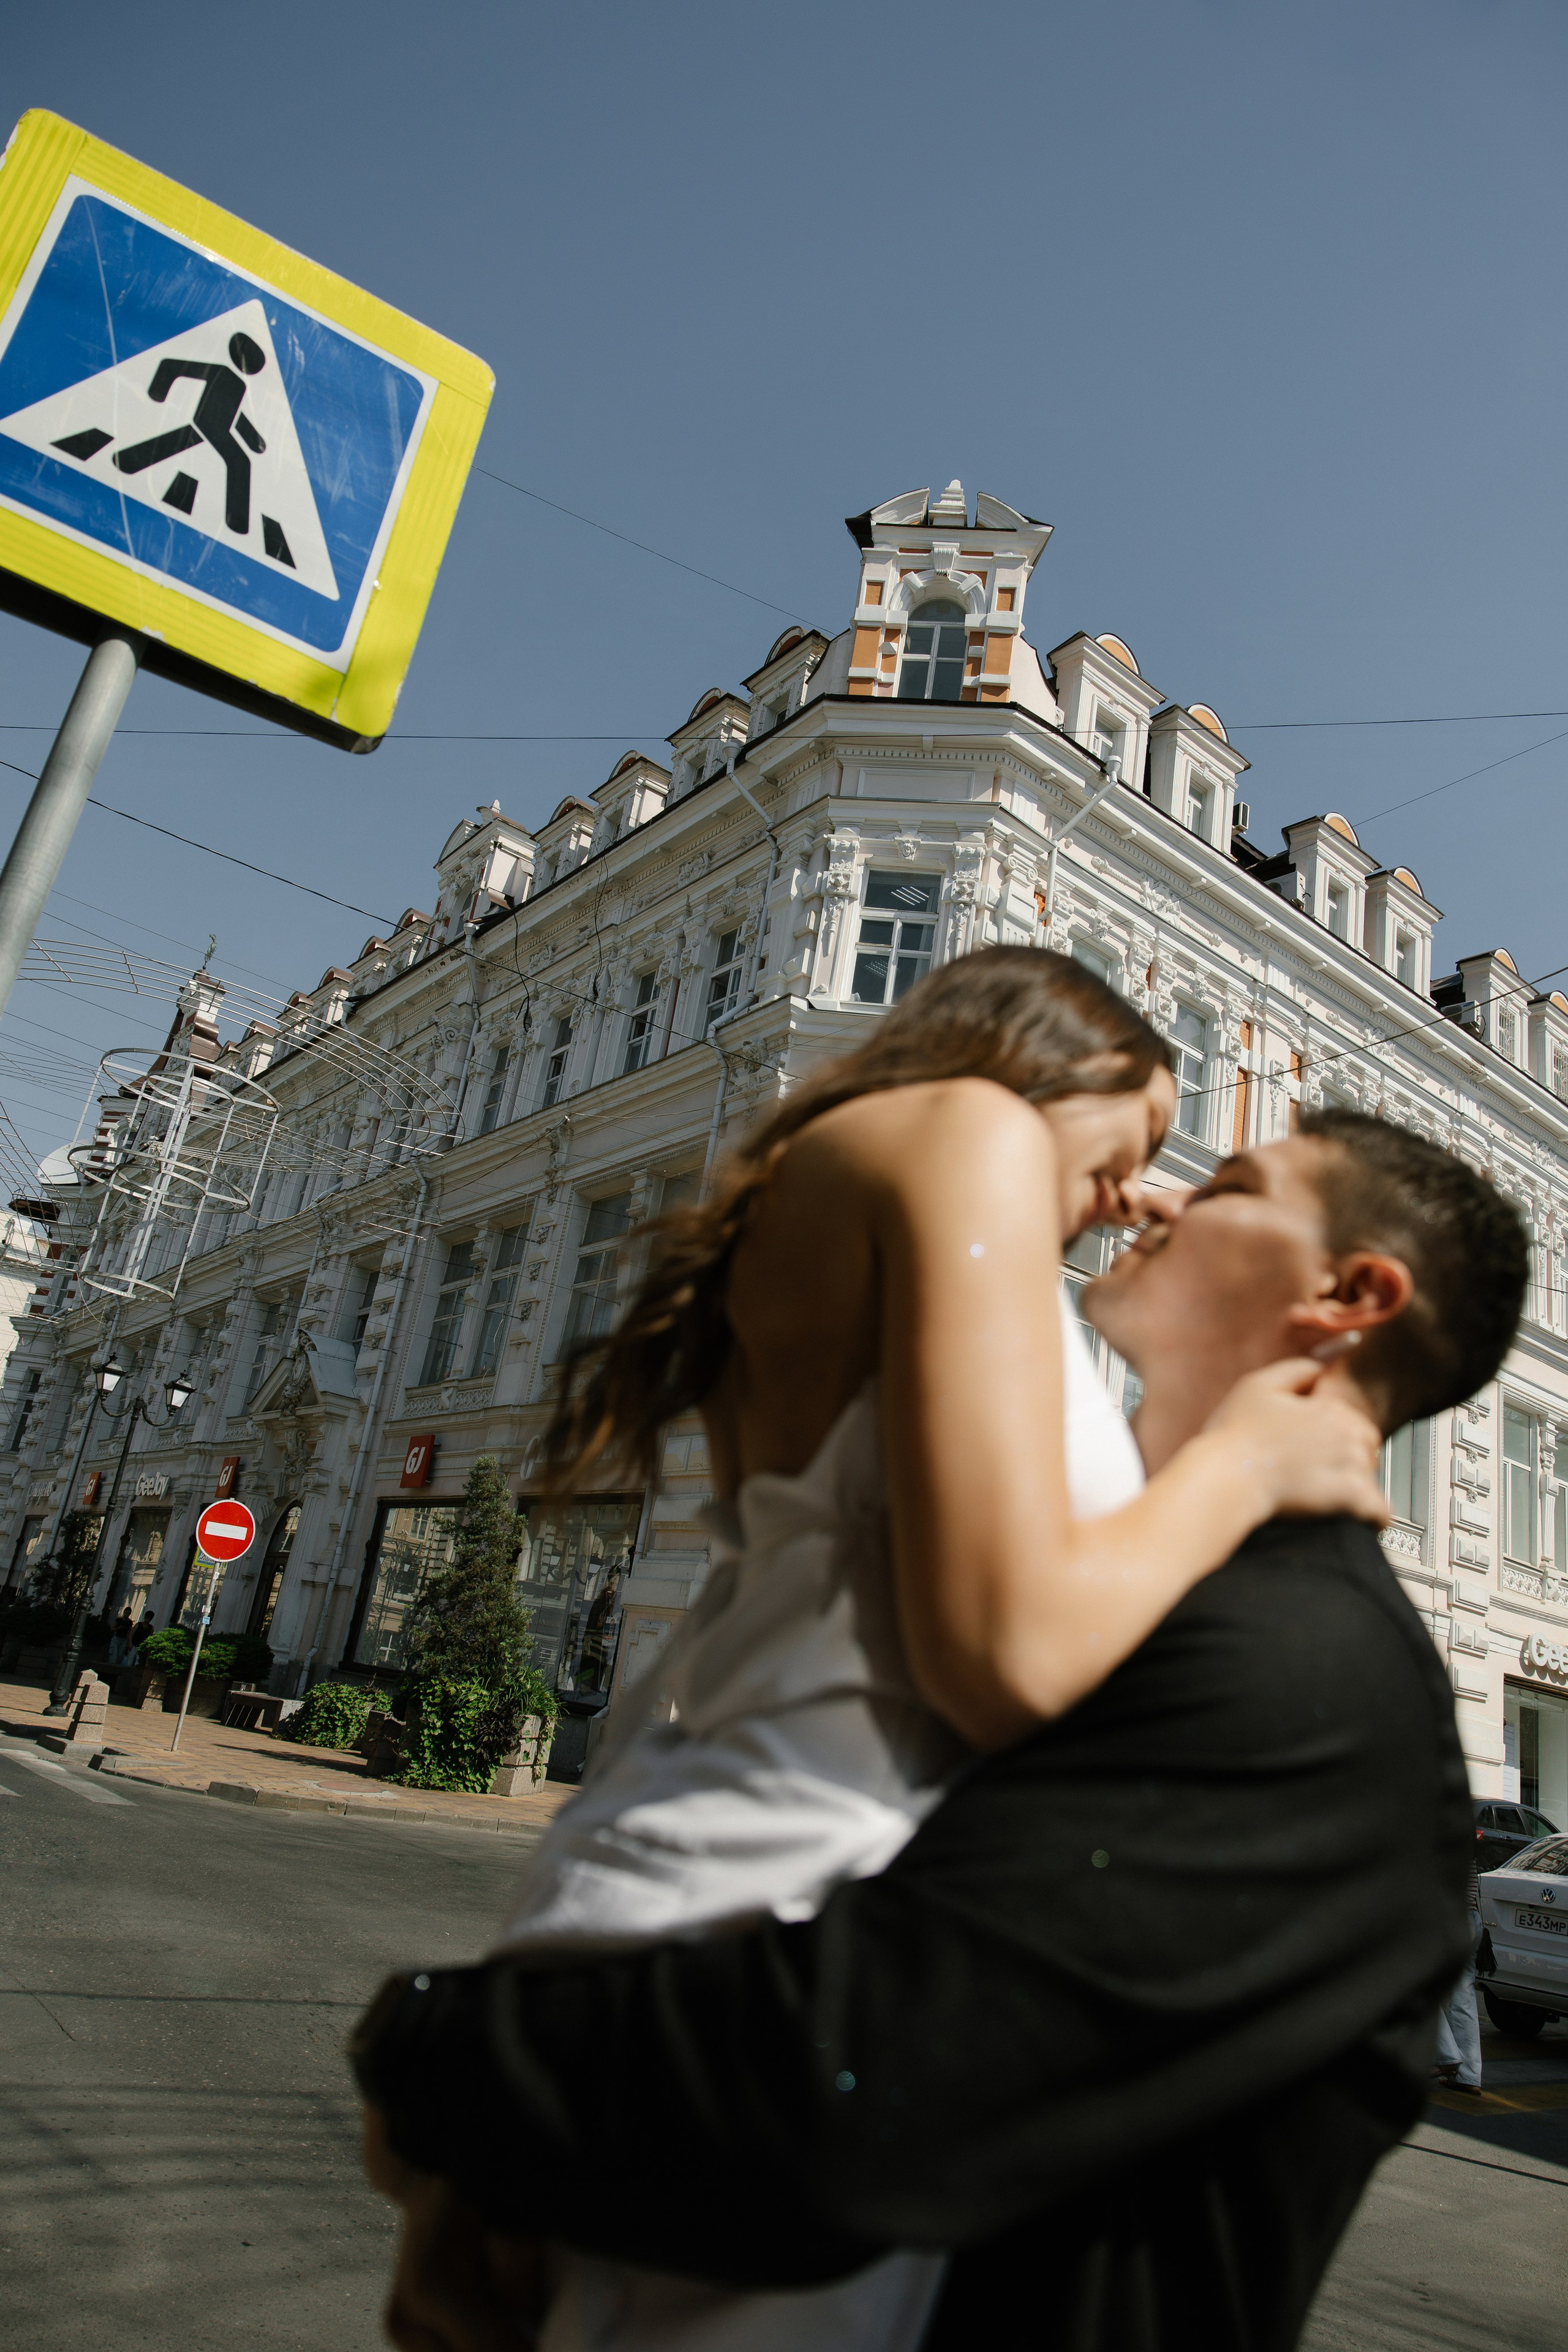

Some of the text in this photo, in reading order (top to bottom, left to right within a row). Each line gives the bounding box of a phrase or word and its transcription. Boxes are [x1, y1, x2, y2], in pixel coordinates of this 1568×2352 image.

[405, 1447, 426, 1474] GJ
[86, 1479, 96, 1496] GJ
[135, 1471, 170, 1501] GeeJay
[219, 1465, 233, 1487] GJ
